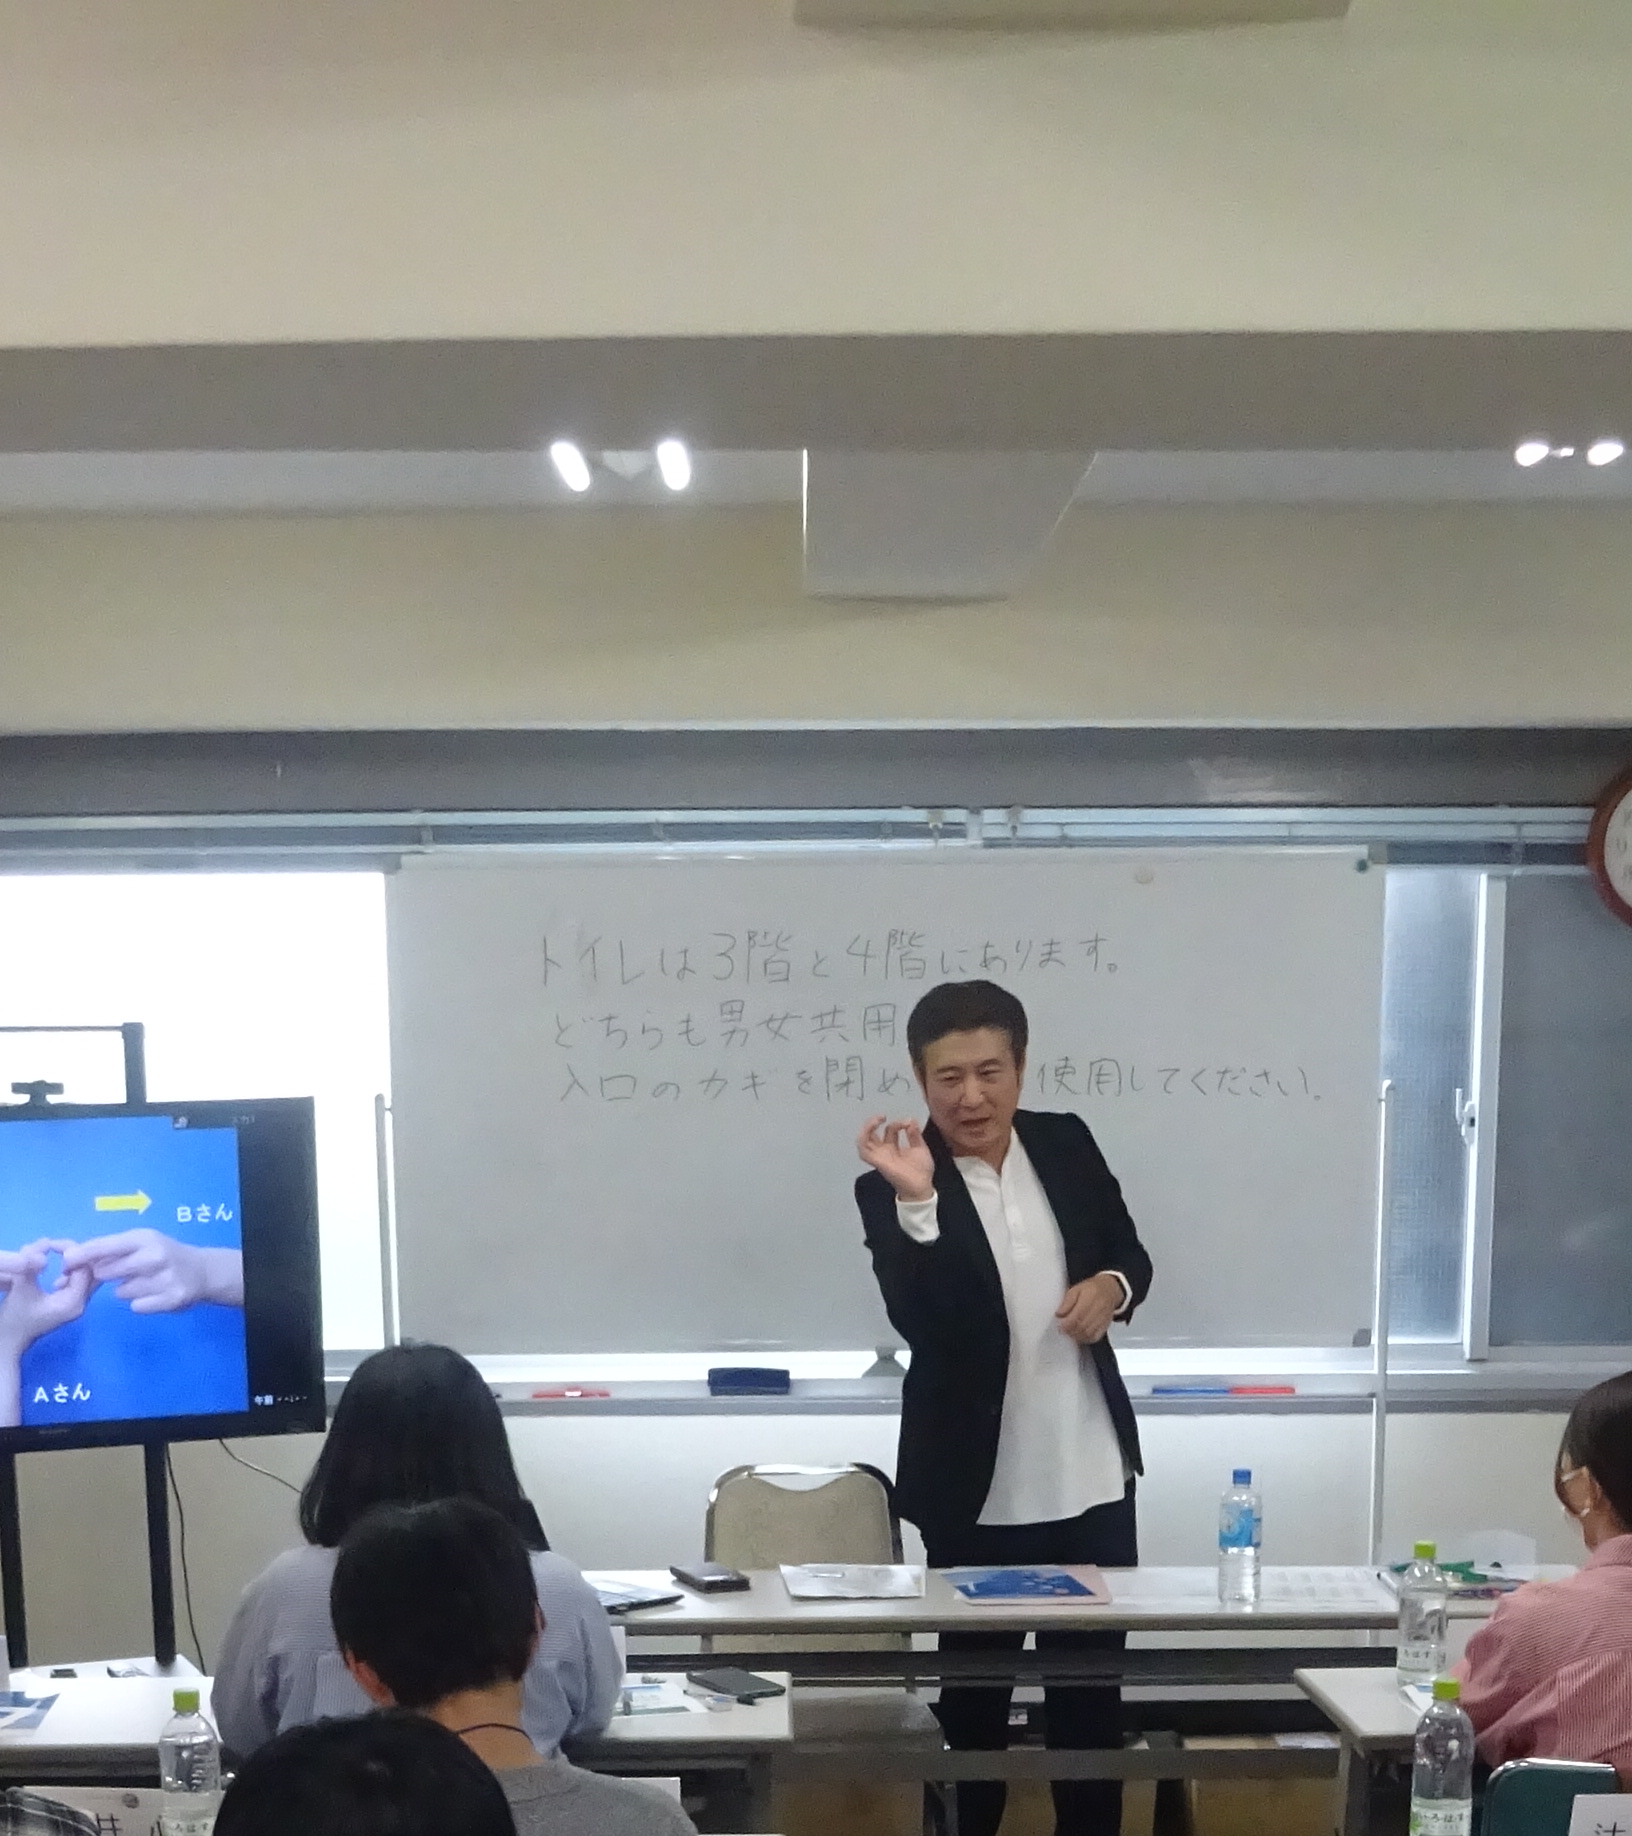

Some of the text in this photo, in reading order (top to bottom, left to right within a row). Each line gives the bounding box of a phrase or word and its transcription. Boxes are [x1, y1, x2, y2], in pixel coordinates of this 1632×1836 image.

[541, 929, 1119, 987] トイレは3階と4階にあります。
[175, 1202, 234, 1223] Bさん
[33, 1382, 91, 1404] Aさん
